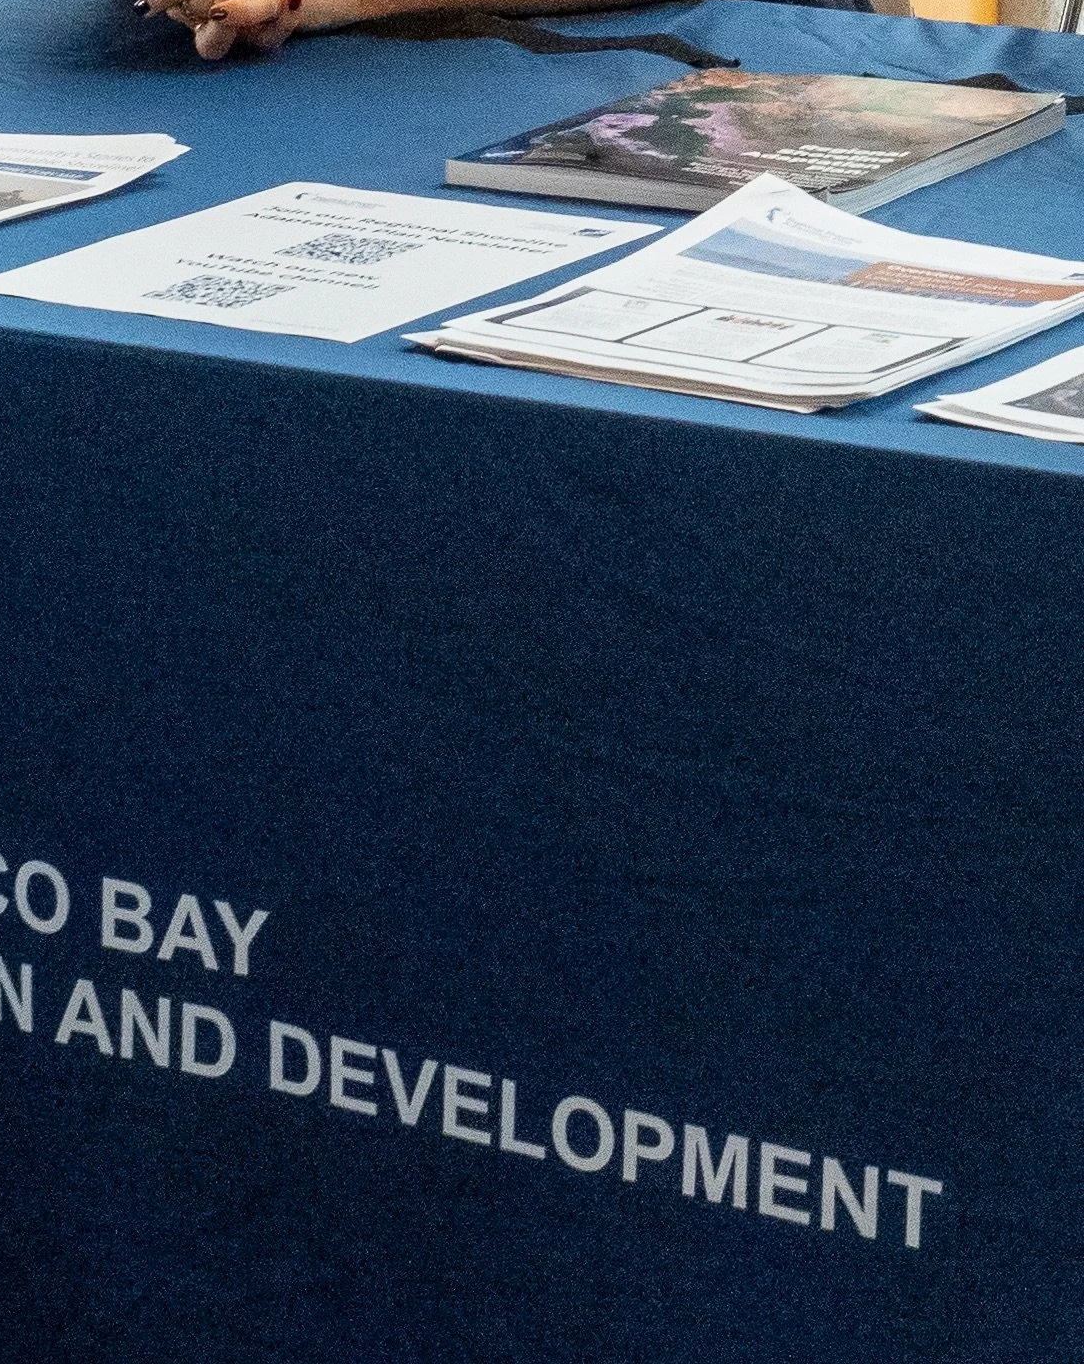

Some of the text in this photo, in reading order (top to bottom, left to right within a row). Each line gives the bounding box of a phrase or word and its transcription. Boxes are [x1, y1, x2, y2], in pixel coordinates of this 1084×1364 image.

[243, 212, 554, 255] Adaptation Plan Newsletter
[265, 205, 311, 215] Join
[359, 216, 457, 236] Regional
[461, 230, 569, 249] Shoreline
[176, 258, 274, 277] YouTube
[207, 252, 382, 281] Watch our new
[101, 877, 268, 976] BAY
[56, 979, 236, 1077] AND
[270, 1021, 944, 1249] DEVELOPMENT
